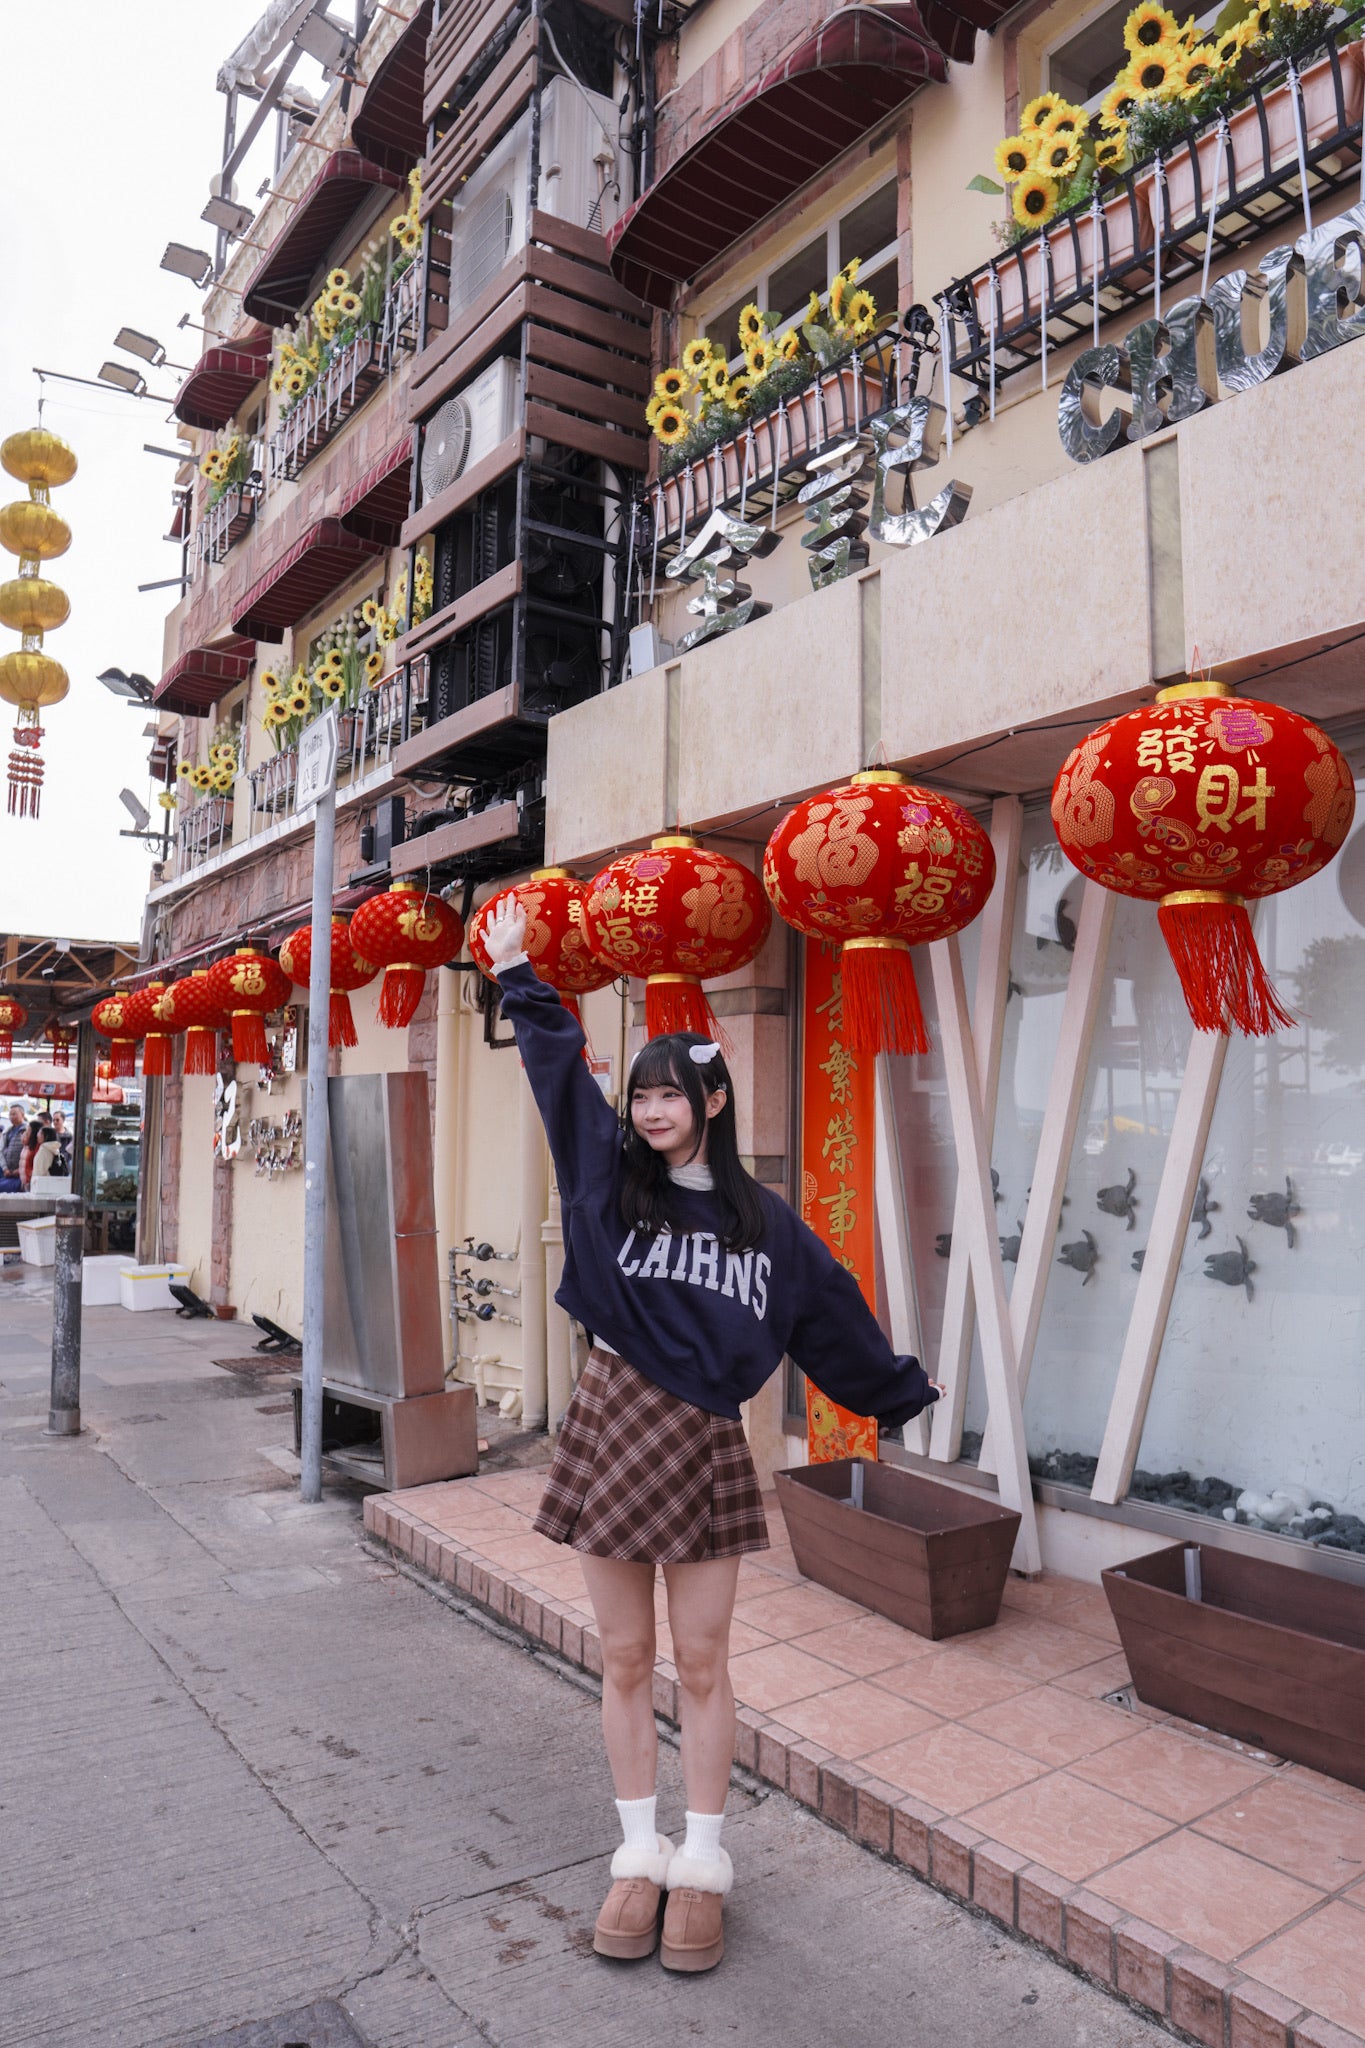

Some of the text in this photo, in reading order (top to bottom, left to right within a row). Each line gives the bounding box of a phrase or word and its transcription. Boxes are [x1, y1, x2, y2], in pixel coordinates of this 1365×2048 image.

[665, 395, 974, 657] 全記
[1137, 724, 1275, 833] 發財
[788, 796, 880, 889] 福
[682, 864, 753, 941] 福
[99, 1003, 125, 1028] 福
[230, 963, 267, 995] 福
